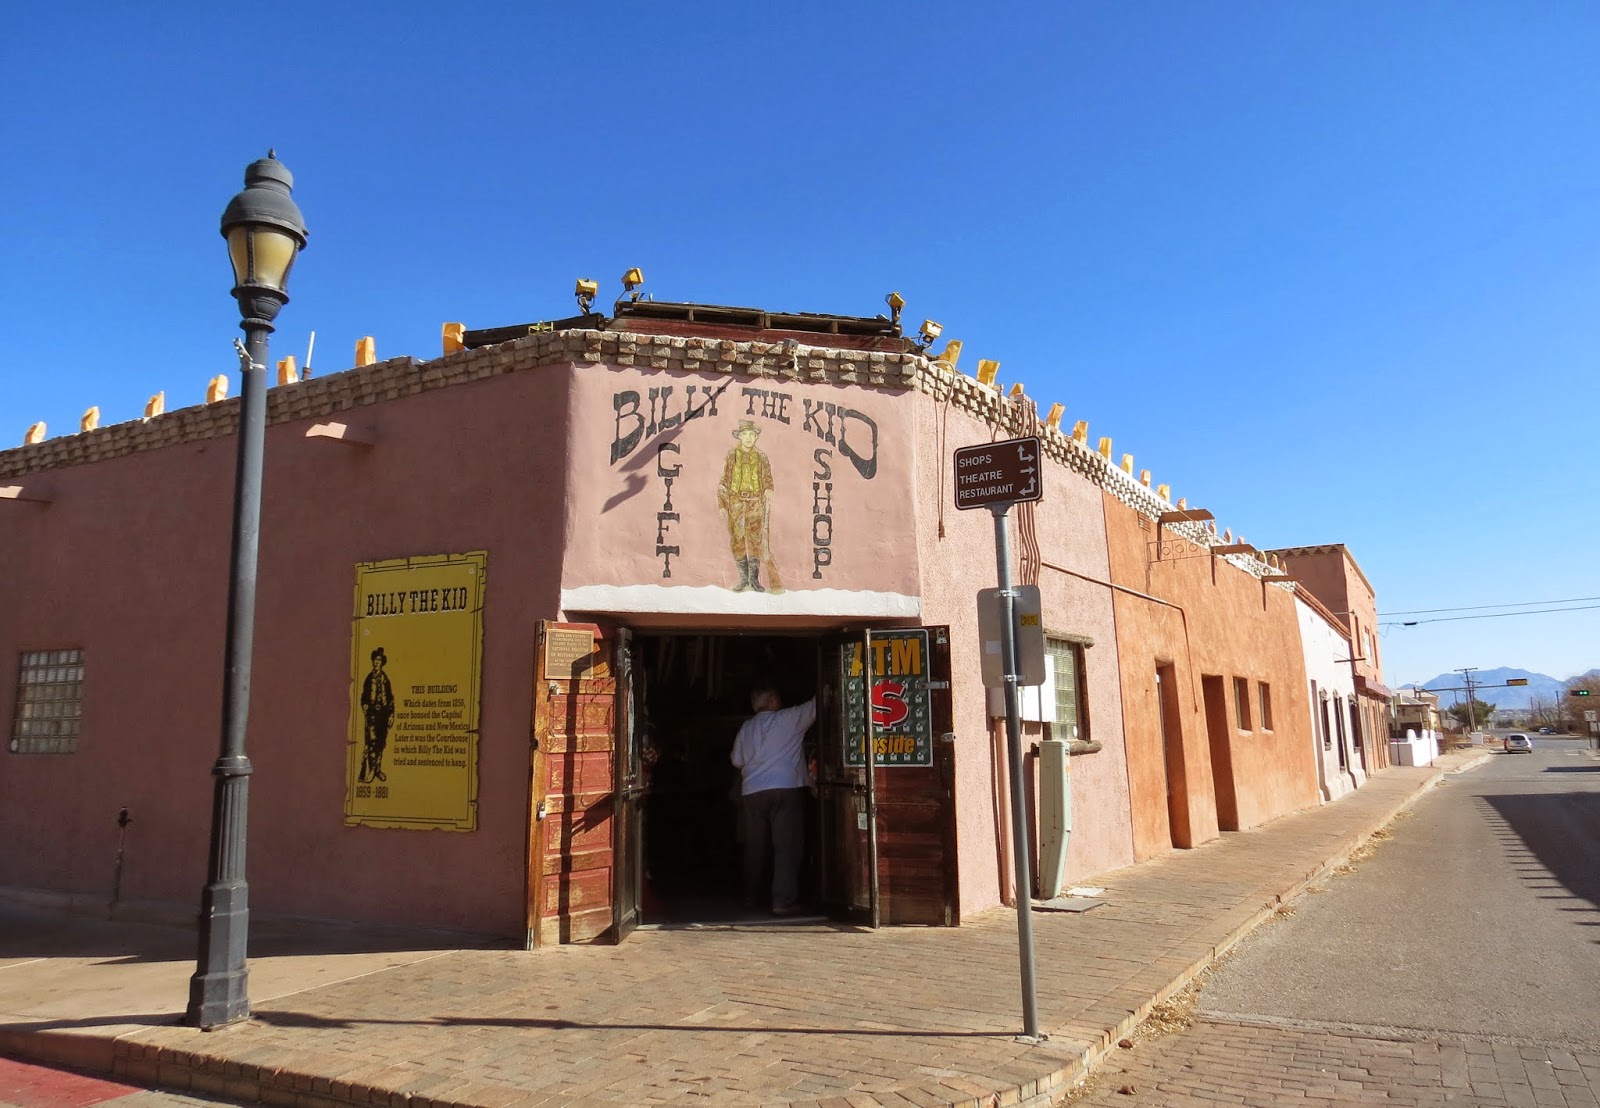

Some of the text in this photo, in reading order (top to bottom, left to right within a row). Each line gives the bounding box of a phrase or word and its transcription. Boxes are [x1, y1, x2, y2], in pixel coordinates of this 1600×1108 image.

[610, 385, 878, 480] BILLY THE KID
[959, 454, 992, 468] SHOPS
[960, 470, 1003, 484] THEATRE
[959, 484, 1013, 499] RESTAURANT
[656, 442, 683, 578] GIFT
[812, 448, 832, 579] SHOP
[366, 587, 467, 616] BILLY THE KID
[412, 684, 458, 694] THIS BUILDING
[403, 699, 421, 708] Which
[422, 699, 437, 708] dates
[437, 698, 451, 708] from
[411, 710, 430, 719] housed
[431, 710, 440, 719] the
[441, 710, 462, 720] Capitol
[403, 722, 424, 731] Arizona
[425, 722, 436, 731] and
[437, 721, 449, 731] New
[395, 734, 409, 742] Later
[426, 733, 435, 742] the
[436, 733, 468, 743] Courthouse
[394, 745, 399, 753] in
[400, 745, 417, 754] which
[418, 745, 432, 755] Billy
[432, 745, 443, 754] The
[443, 745, 454, 754] Kid
[394, 757, 406, 766] tried
[407, 757, 417, 766] and
[418, 757, 444, 767] sentenced
